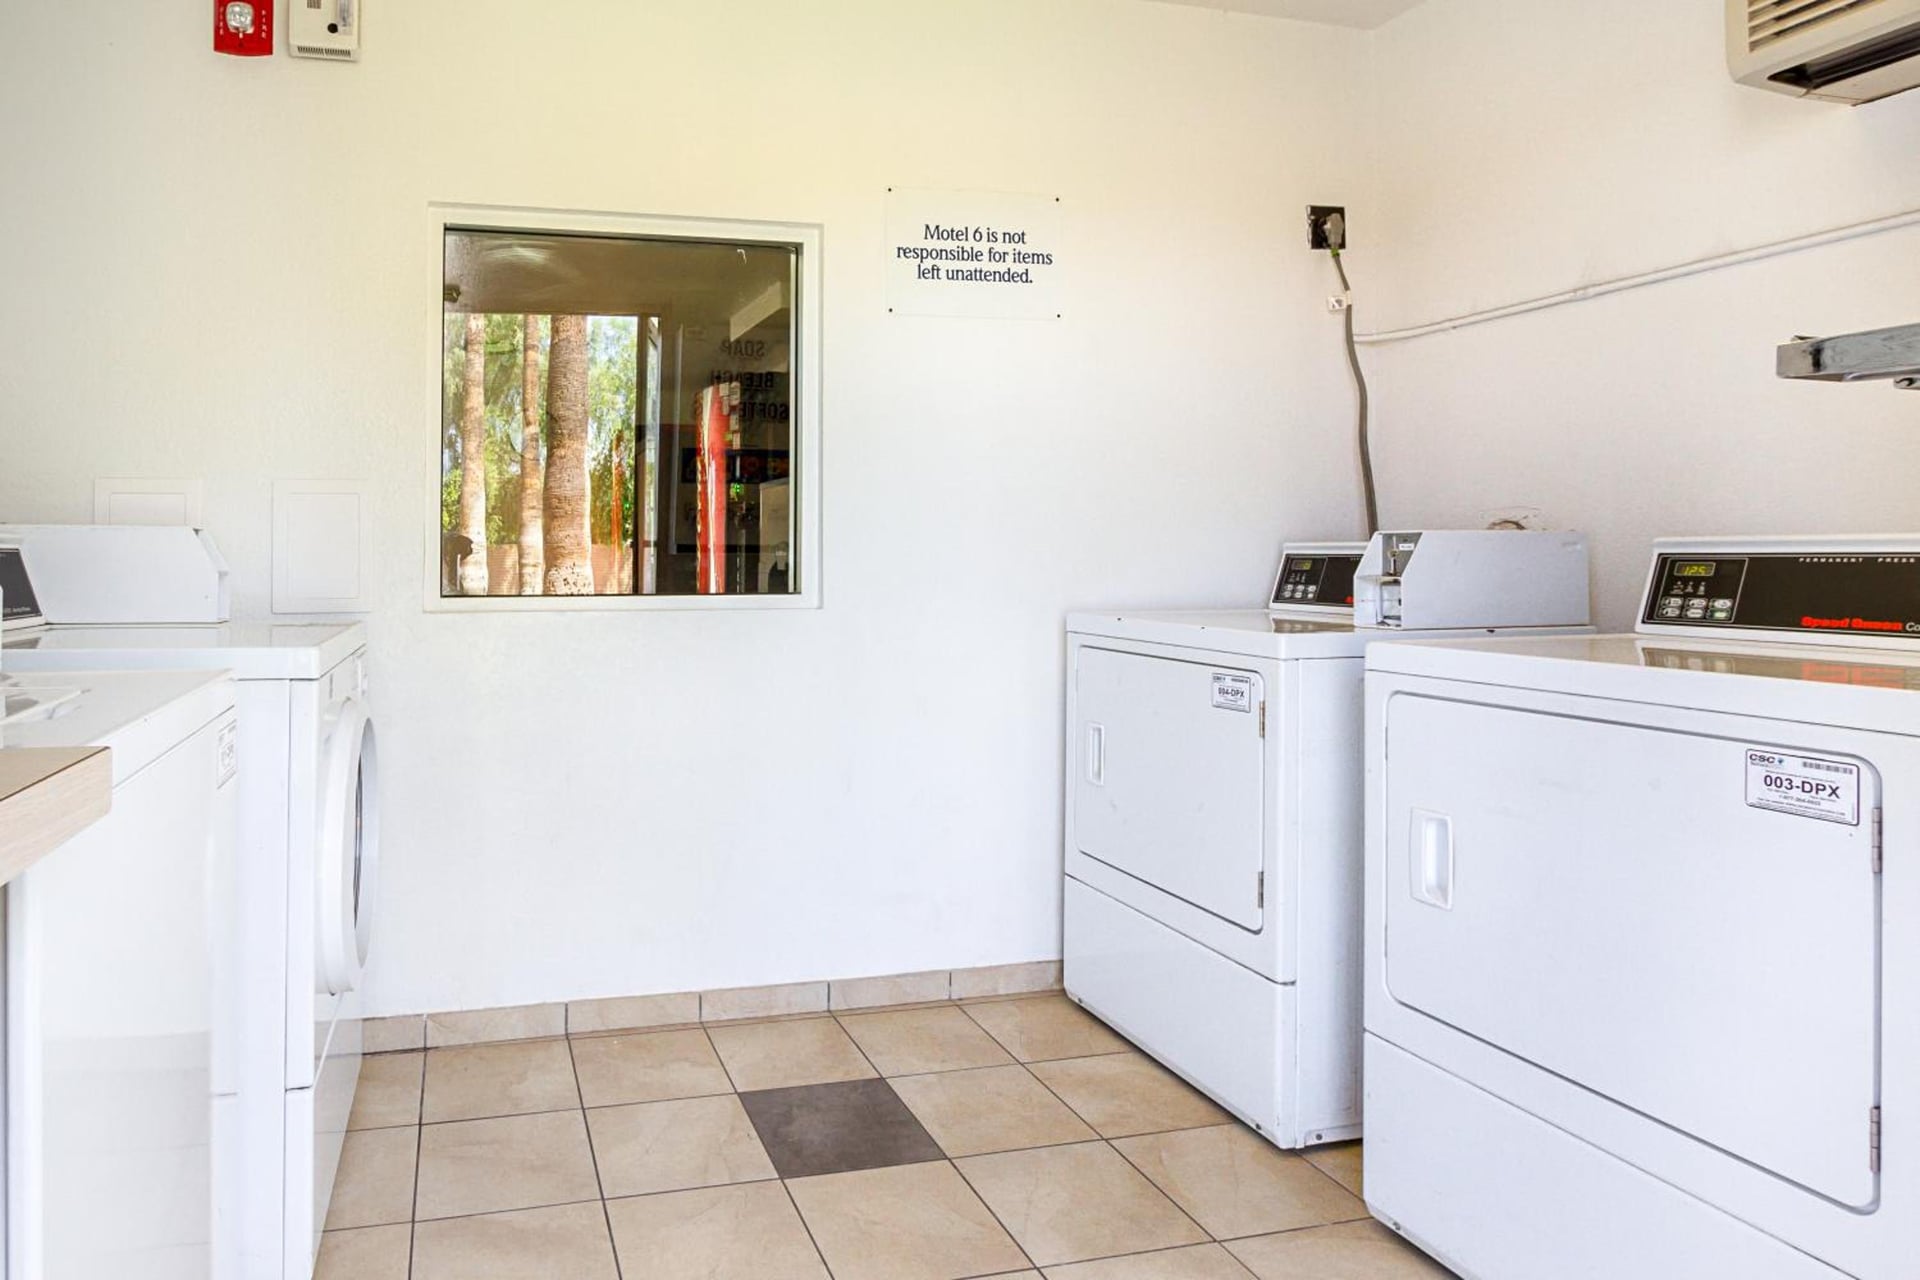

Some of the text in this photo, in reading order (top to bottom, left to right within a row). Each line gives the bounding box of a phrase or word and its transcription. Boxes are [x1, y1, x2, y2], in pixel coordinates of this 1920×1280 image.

[924, 224, 1026, 244] Motel 6 is not
[896, 246, 1054, 265] responsible for items
[917, 264, 1034, 284] left unattended.
[1749, 753, 1777, 765] CSC
[1763, 774, 1841, 800] 003-DPX
